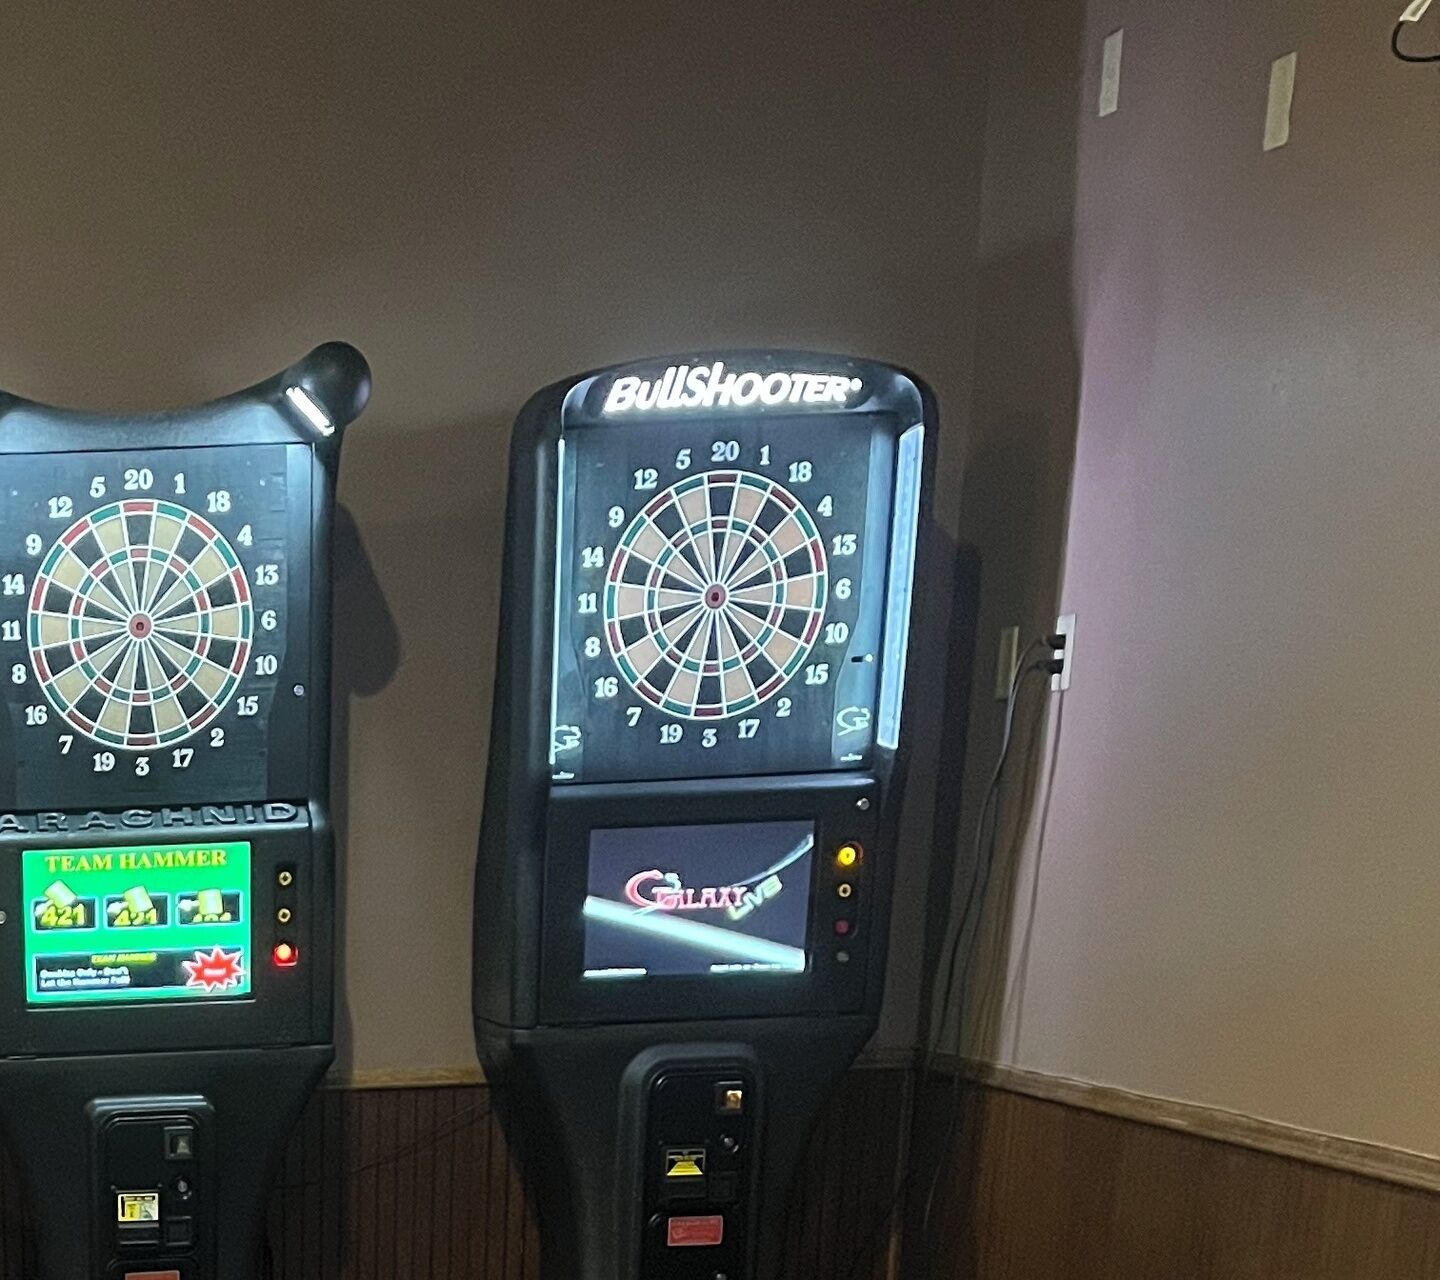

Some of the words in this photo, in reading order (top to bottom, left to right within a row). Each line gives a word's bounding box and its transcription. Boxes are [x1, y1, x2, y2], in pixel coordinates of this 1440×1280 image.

[675, 448, 691, 470] 5
[710, 440, 740, 462] 20
[759, 444, 770, 466] 1
[123, 468, 154, 491] 20
[173, 472, 186, 494] 1
[634, 468, 659, 490] 12
[788, 461, 813, 483] 18
[89, 476, 106, 499] 5
[47, 495, 73, 519] 12
[206, 490, 231, 513] 18
[816, 495, 833, 517] 4
[608, 505, 625, 528] 9
[25, 533, 43, 556] 9
[236, 524, 253, 547] 4
[832, 533, 857, 556] 13
[581, 546, 605, 569] 14
[1, 573, 25, 596] 14
[255, 564, 279, 586] 13
[835, 577, 852, 600] 6
[577, 592, 598, 614] 11
[1, 619, 22, 641] 11
[260, 609, 277, 631] 6
[824, 622, 849, 645] 10
[584, 636, 602, 658] 8
[11, 663, 27, 685] 8
[254, 654, 278, 676] 10
[805, 663, 829, 685] 15
[594, 676, 619, 698] 16
[25, 704, 48, 726] 16
[236, 695, 259, 716] 15
[626, 706, 643, 727] 7
[775, 697, 792, 718] 2
[210, 727, 225, 747] 2
[659, 723, 683, 744] 19
[701, 728, 717, 748] 3
[737, 718, 761, 739] 17
[58, 734, 74, 755] 7
[92, 751, 116, 772] 19
[135, 756, 150, 776] 3
[172, 748, 194, 768] 17
[45, 853, 112, 873] TEAM
[119, 849, 227, 869] HAMMER
